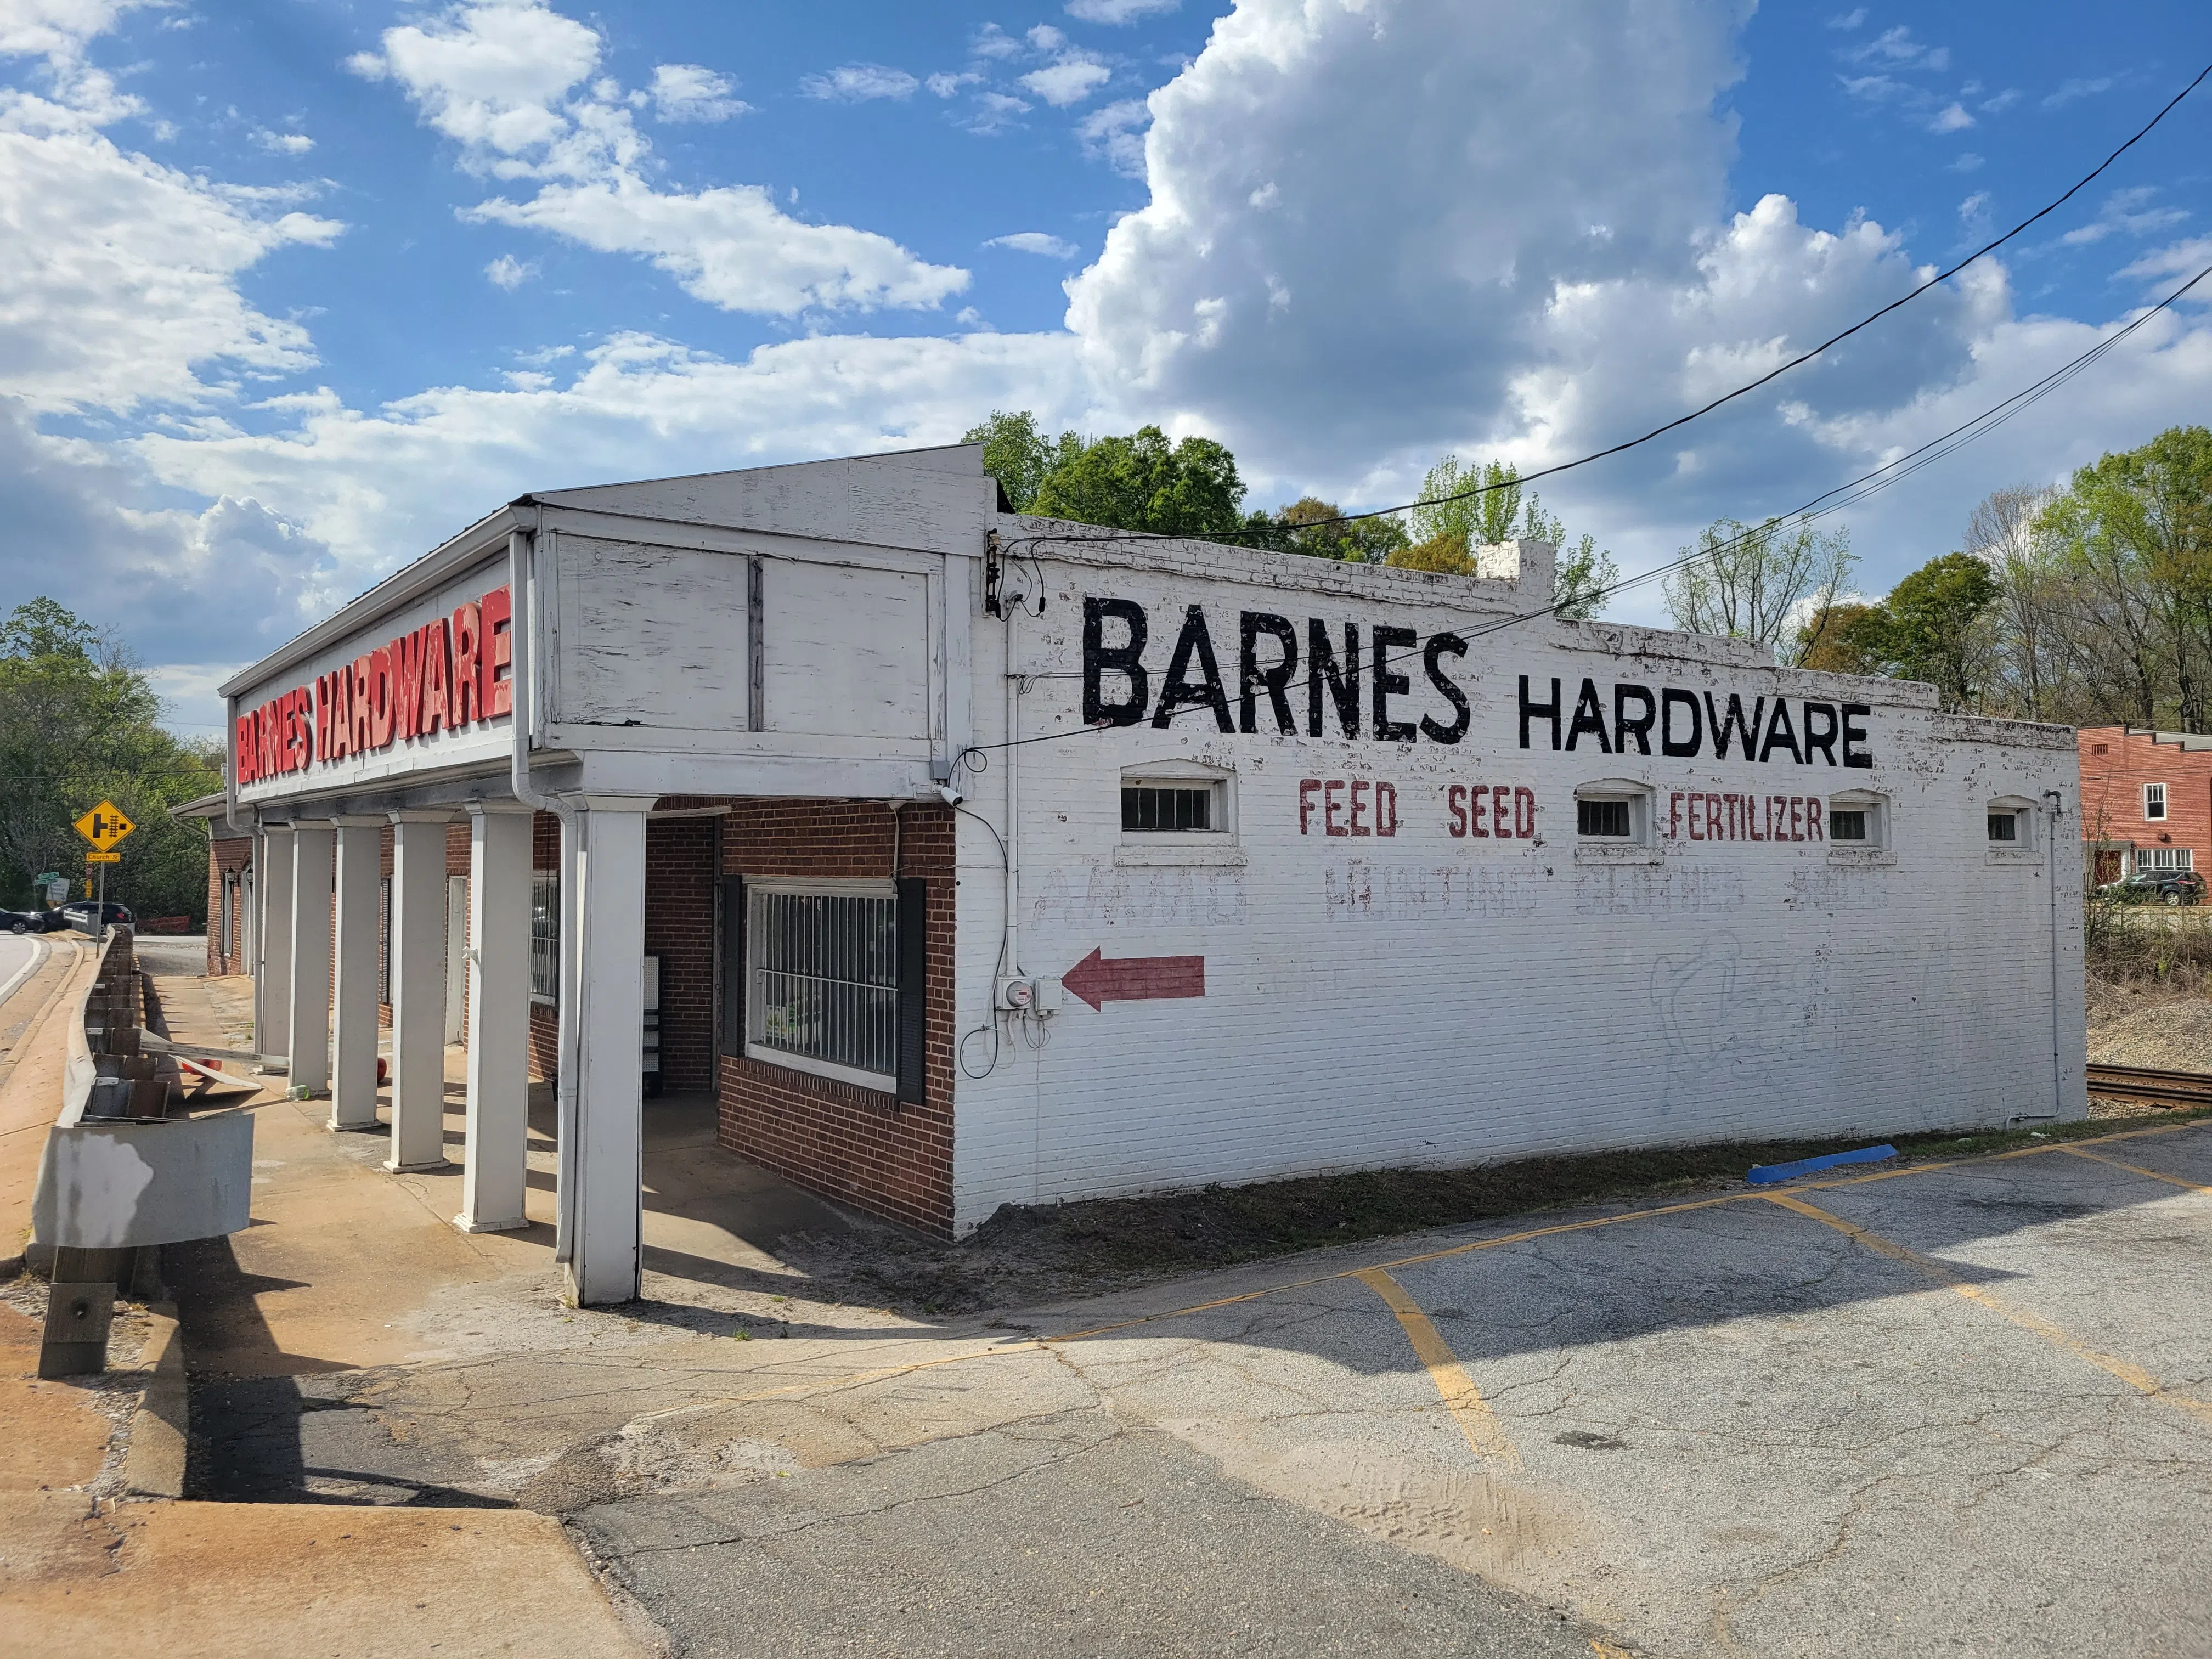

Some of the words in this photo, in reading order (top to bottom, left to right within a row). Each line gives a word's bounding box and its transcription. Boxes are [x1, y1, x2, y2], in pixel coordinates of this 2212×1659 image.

[236, 686, 312, 784] BARNES
[316, 583, 512, 762] HARDWARE
[1083, 596, 1471, 746] BARNES
[1518, 674, 1874, 769] HARDWARE
[1299, 778, 1396, 837] FEED
[1449, 785, 1535, 839] SEED
[1670, 792, 1824, 842] FERTILIZER
